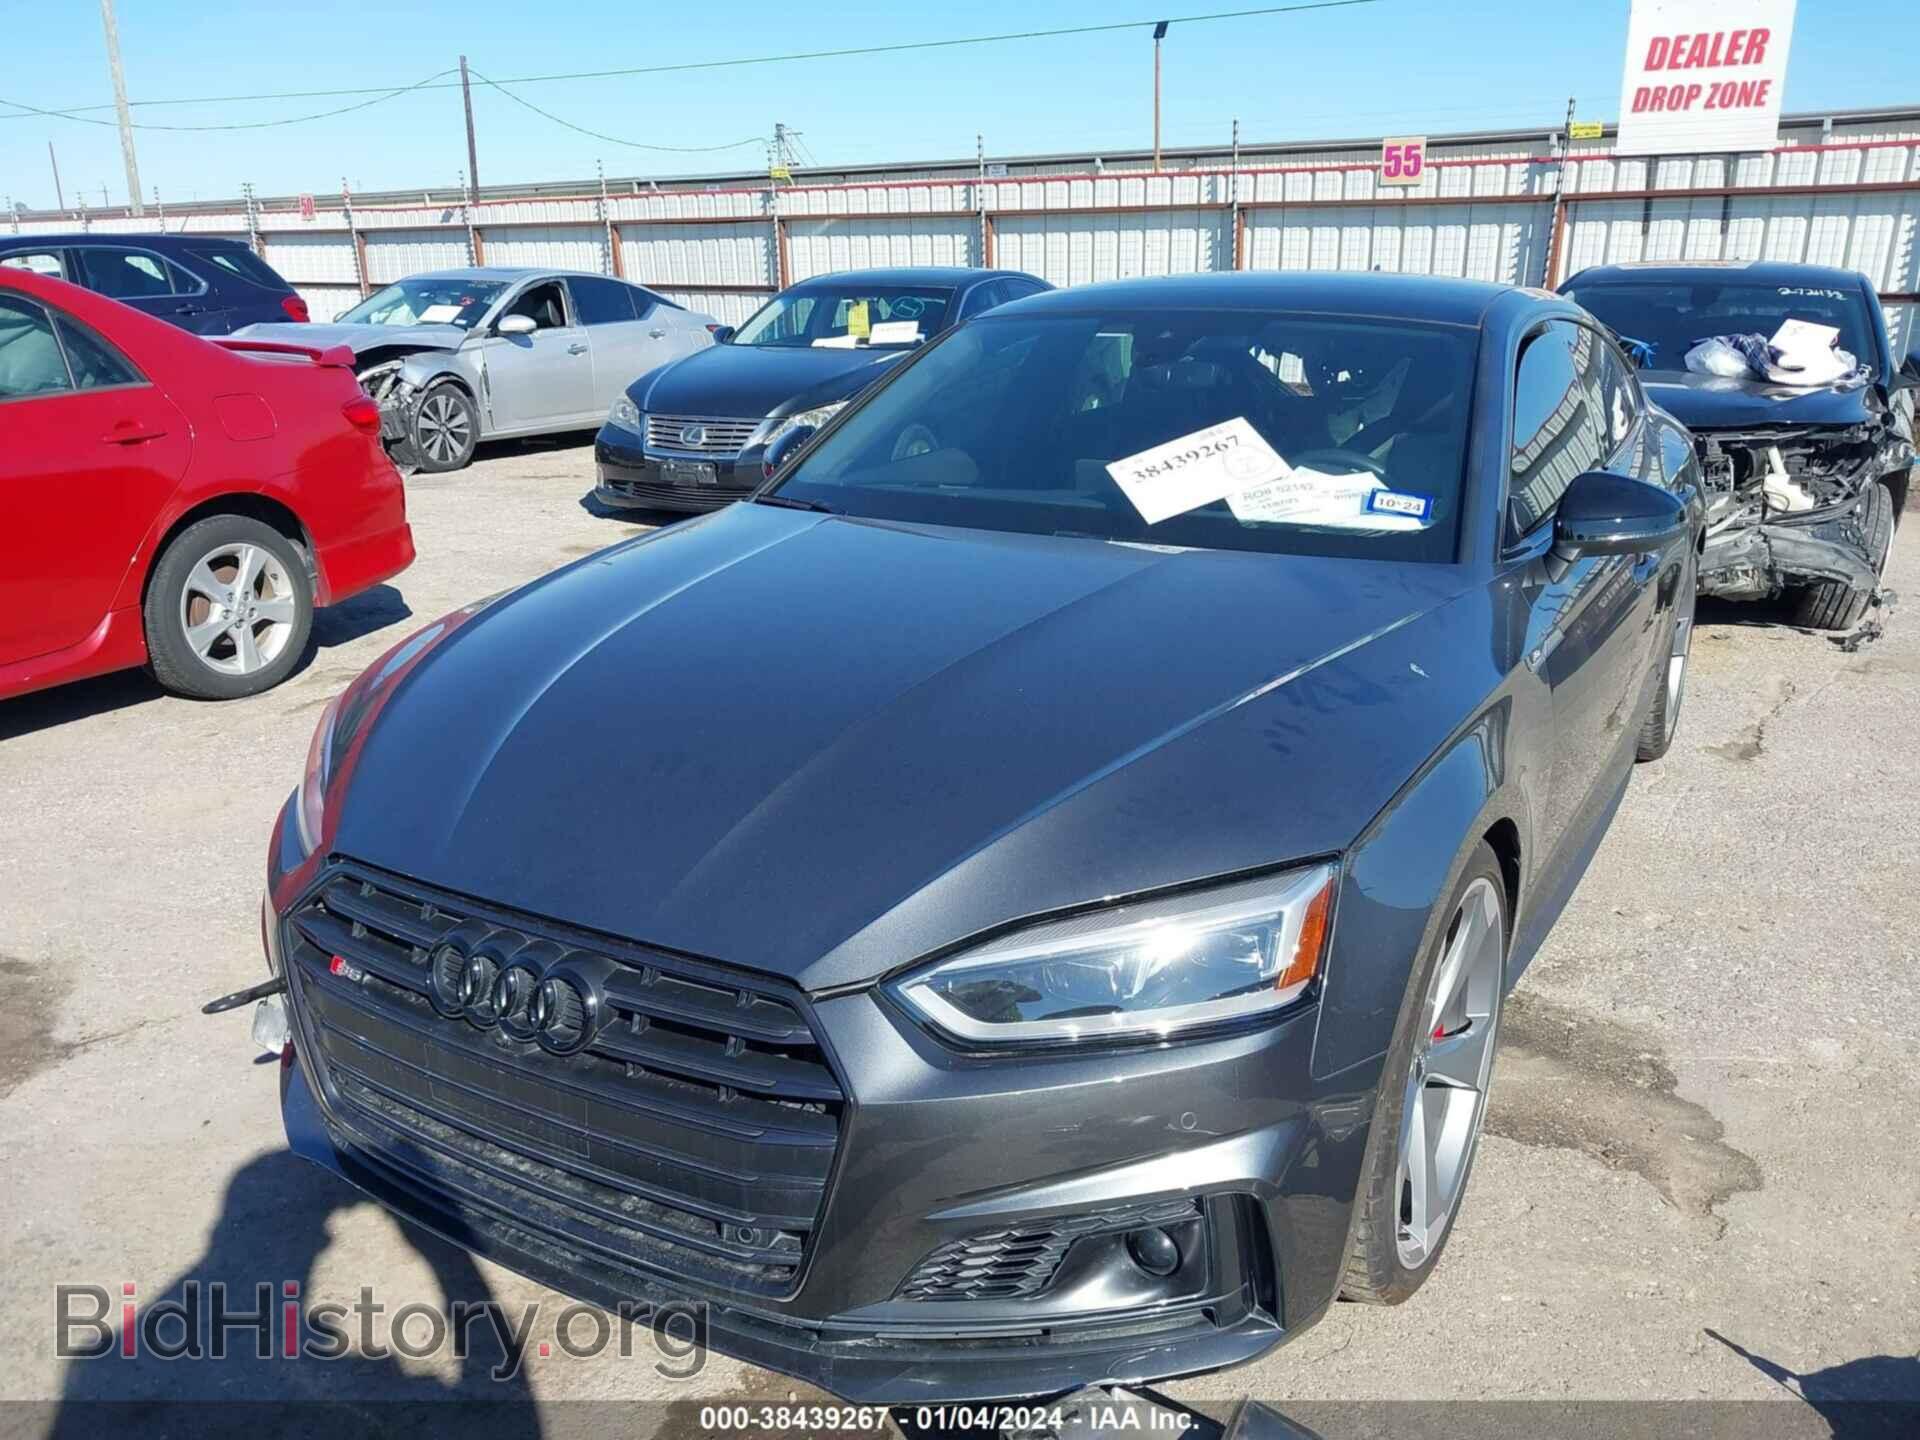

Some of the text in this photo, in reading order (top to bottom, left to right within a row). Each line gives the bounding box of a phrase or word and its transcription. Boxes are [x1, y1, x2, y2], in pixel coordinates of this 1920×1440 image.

[1643, 28, 1771, 71] DEALER
[1631, 79, 1773, 113] DROP ZONE
[1383, 144, 1422, 178] 55
[1132, 434, 1239, 484] 38439267
